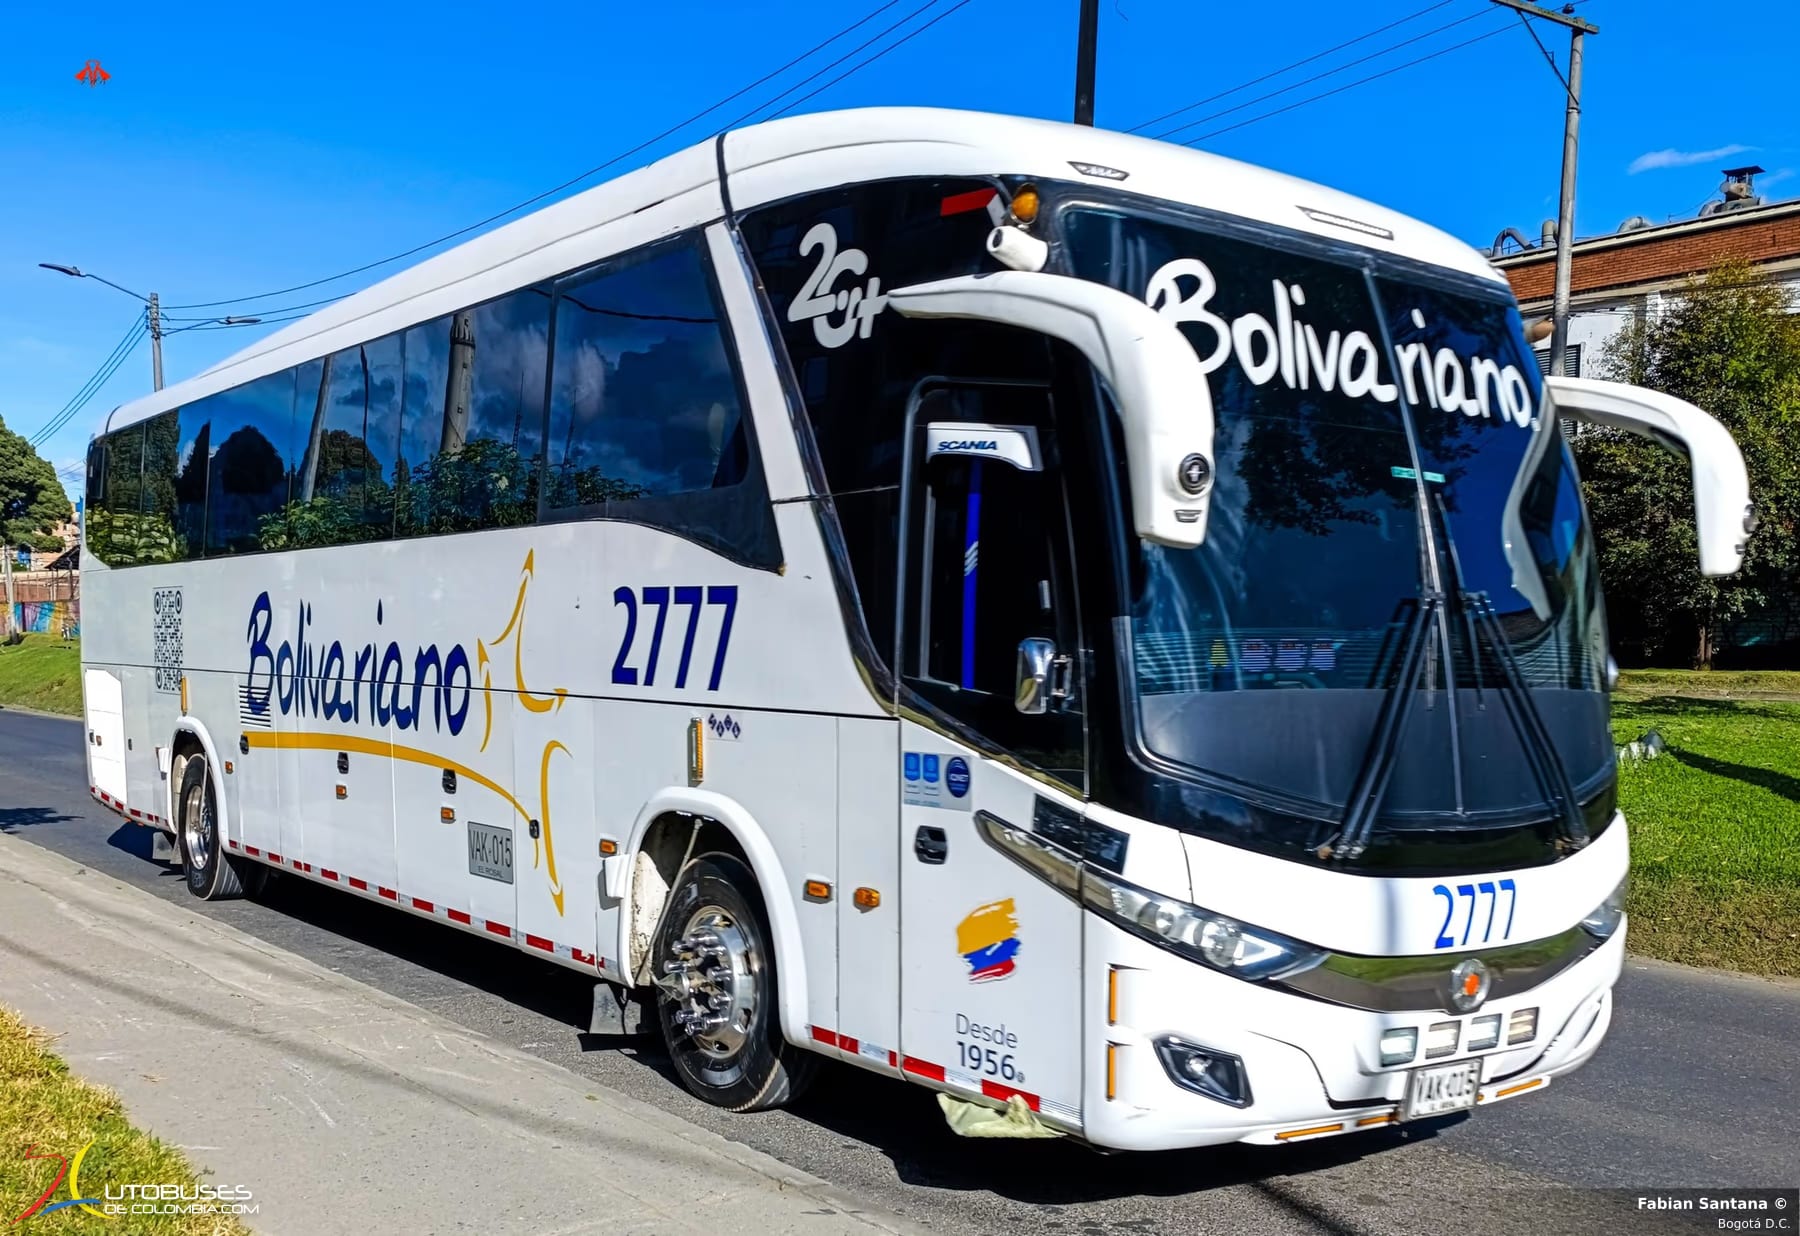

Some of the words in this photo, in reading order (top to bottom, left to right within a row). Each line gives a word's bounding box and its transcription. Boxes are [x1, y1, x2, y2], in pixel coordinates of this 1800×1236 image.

[1146, 258, 1533, 428] Bolivariano
[938, 440, 998, 450] SCANIA
[247, 591, 471, 736] Bolivariano
[611, 585, 738, 691] 2777
[1432, 878, 1516, 949] 2777
[956, 1013, 1018, 1049] Desde
[957, 1040, 1015, 1081] 1956
